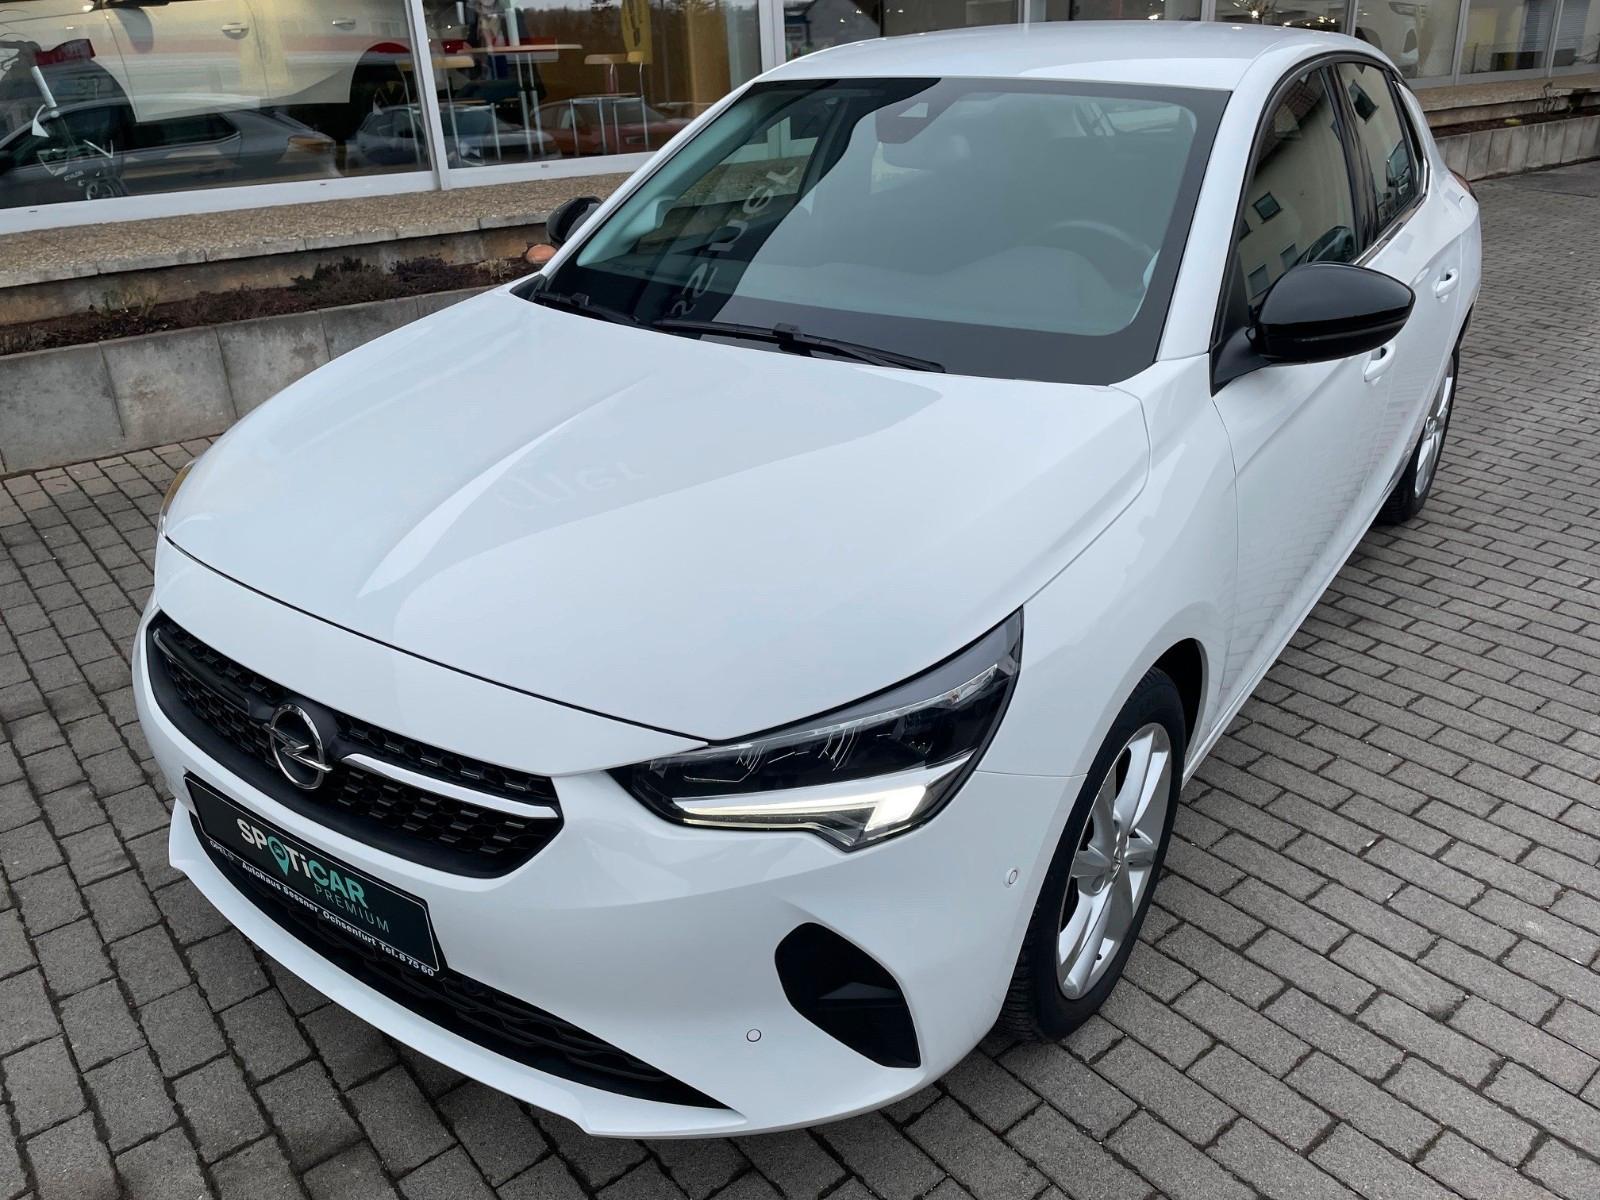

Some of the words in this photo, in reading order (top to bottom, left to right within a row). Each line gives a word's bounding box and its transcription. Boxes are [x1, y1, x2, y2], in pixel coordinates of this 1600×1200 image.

[242, 861, 281, 890] Autohaus
[283, 886, 318, 912] Sessner
[323, 910, 377, 946] Ochsenfurt
[313, 882, 390, 933] PREMIUM
